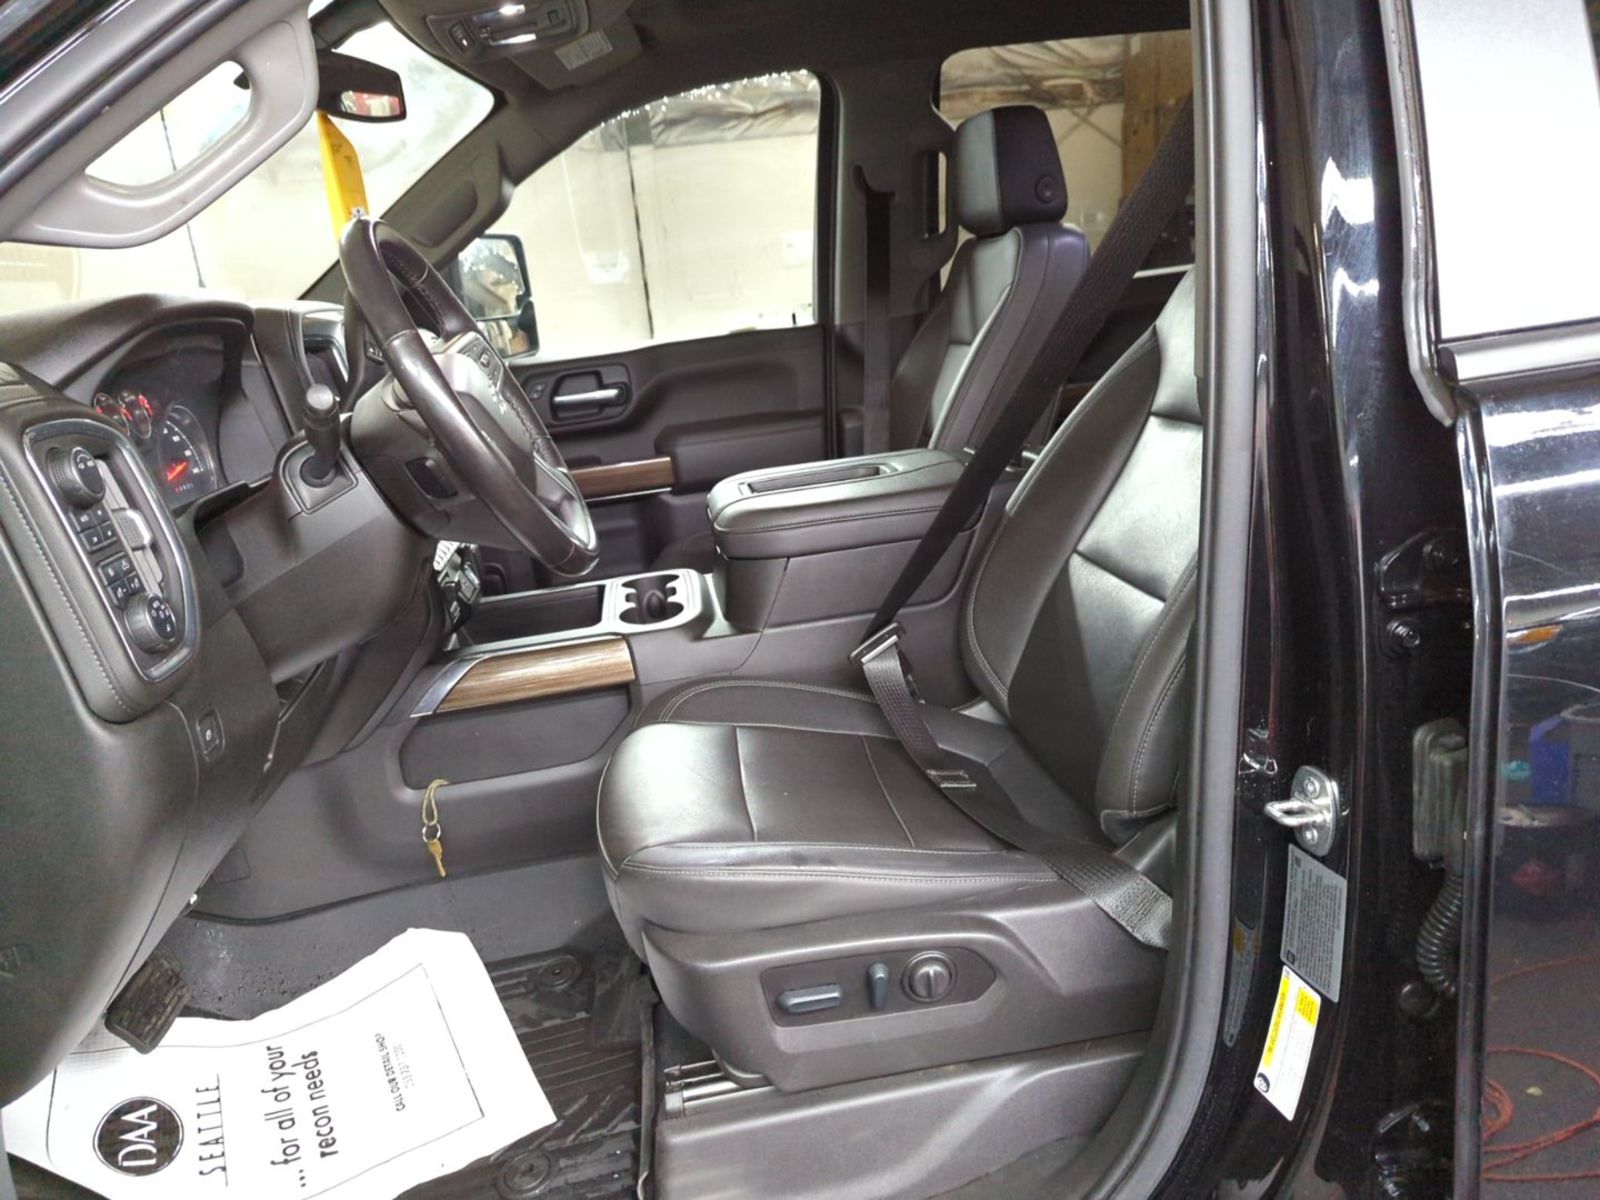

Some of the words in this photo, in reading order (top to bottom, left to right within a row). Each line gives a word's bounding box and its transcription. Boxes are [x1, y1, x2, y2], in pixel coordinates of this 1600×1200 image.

[266, 1045, 297, 1082] your
[291, 1050, 327, 1101] needs
[260, 1086, 292, 1103] of
[264, 1108, 296, 1131] all
[118, 1103, 158, 1167] DAA
[195, 1087, 226, 1175] SEATTLE
[311, 1104, 339, 1158] recon
